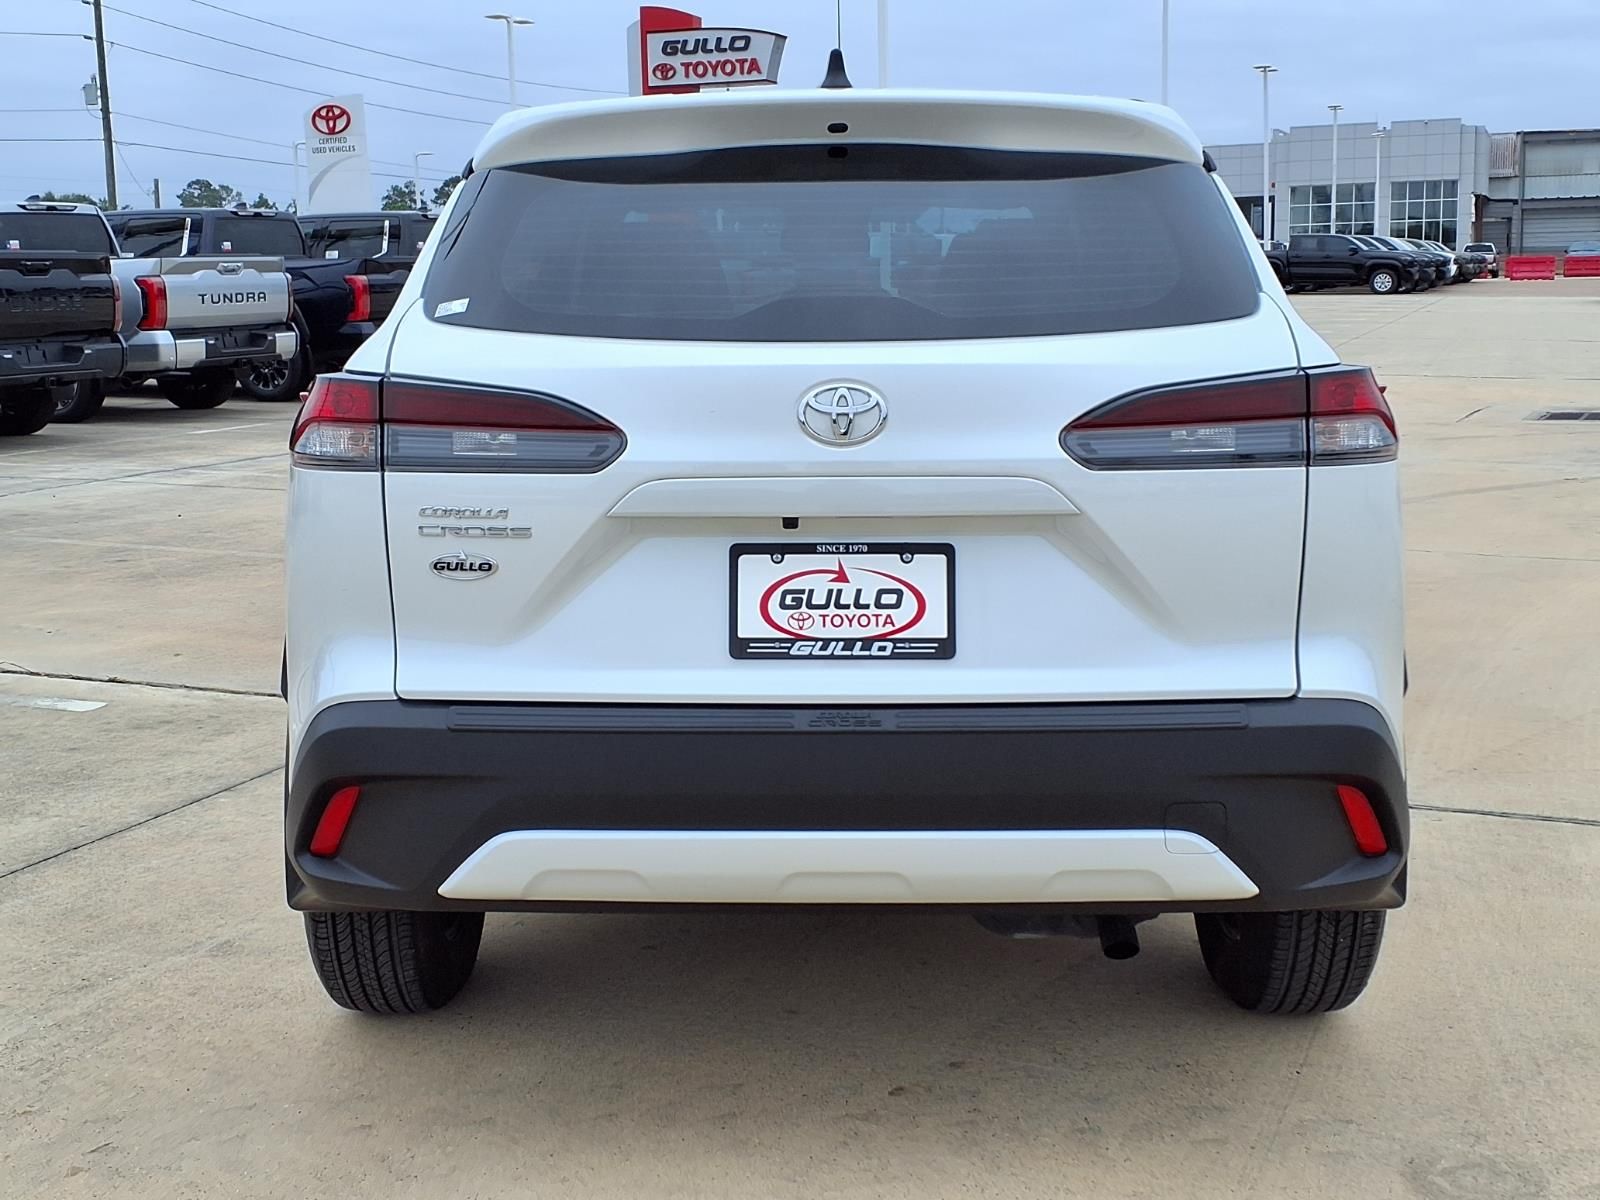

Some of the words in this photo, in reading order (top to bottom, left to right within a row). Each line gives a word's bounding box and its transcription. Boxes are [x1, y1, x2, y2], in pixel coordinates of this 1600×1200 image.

[661, 35, 751, 56] GULLO
[680, 58, 762, 78] TOYOTA
[318, 136, 348, 145] CERTIFIED
[311, 146, 327, 154] USED
[327, 145, 356, 153] VEHICLES
[197, 291, 267, 305] TUNDRA
[419, 505, 509, 520] COROLLA
[418, 525, 533, 539] CROSS
[816, 544, 846, 553] SINCE
[848, 544, 868, 553] 1970
[433, 561, 493, 572] GULLO
[778, 588, 904, 610] GULLO
[818, 613, 896, 628] TOYOTA
[789, 641, 894, 656] GULLO
